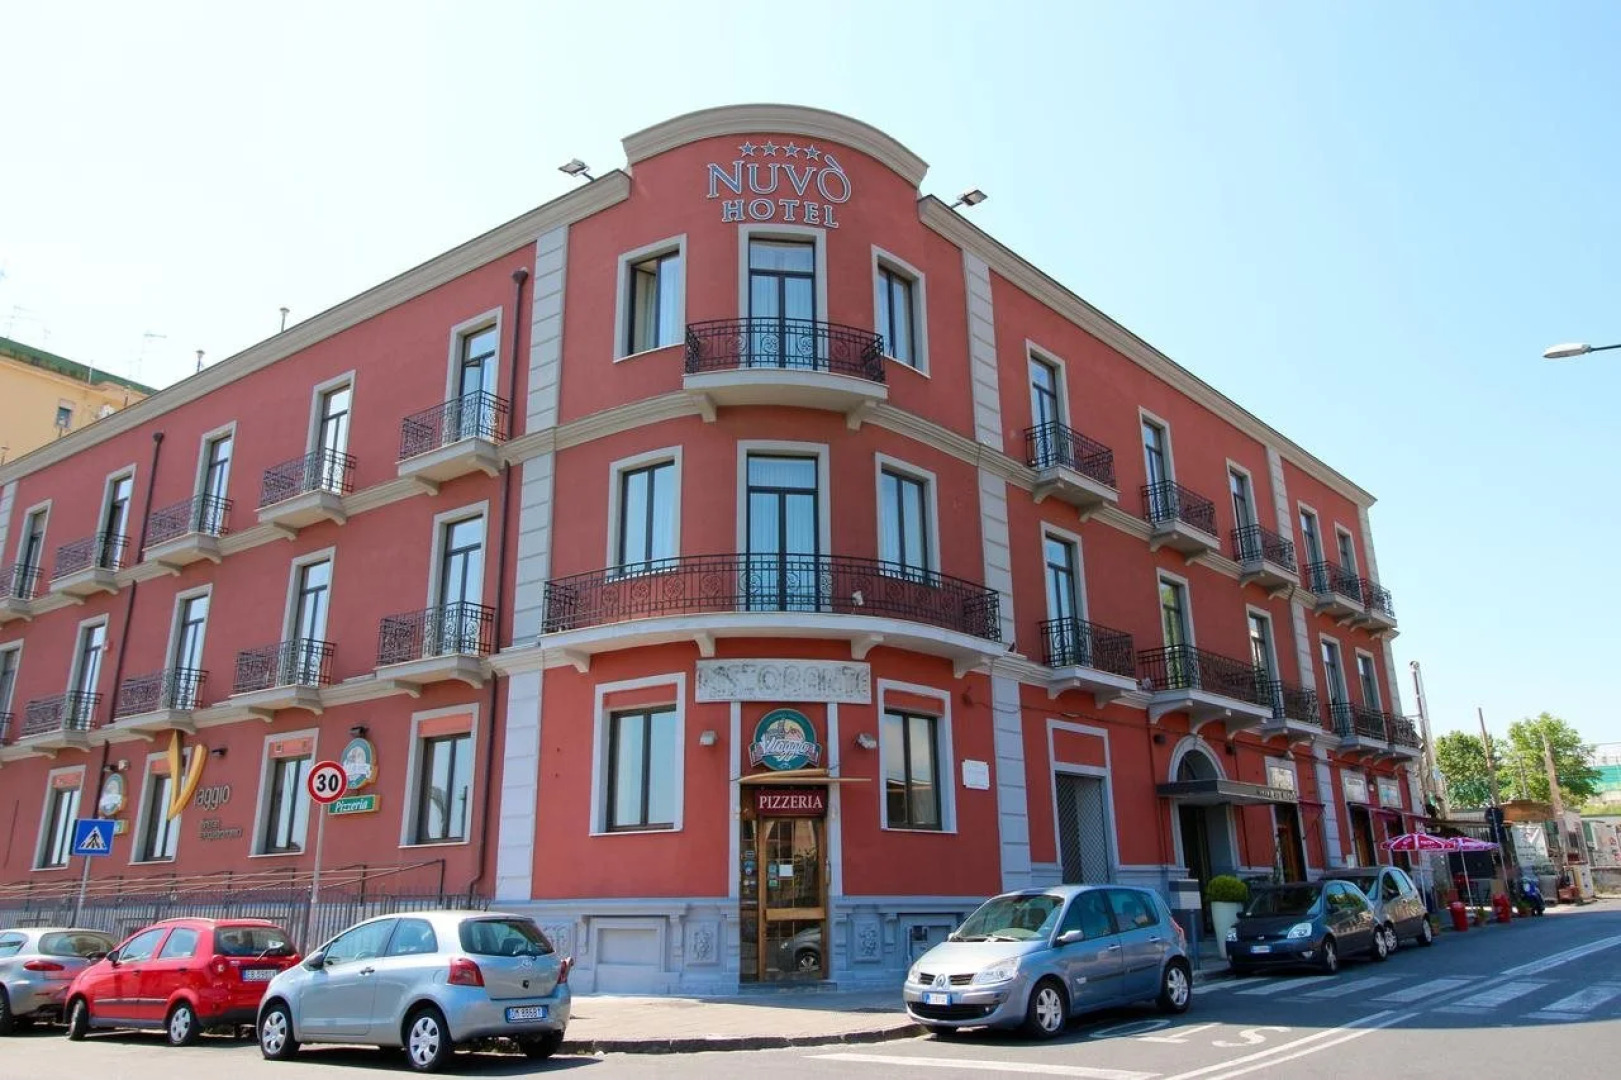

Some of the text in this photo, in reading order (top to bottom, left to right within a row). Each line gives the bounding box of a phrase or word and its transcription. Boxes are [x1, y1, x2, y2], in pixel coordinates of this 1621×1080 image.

[722, 198, 839, 228] HOTEL
[316, 773, 340, 793] 30
[759, 795, 823, 809] PIZZERIA
